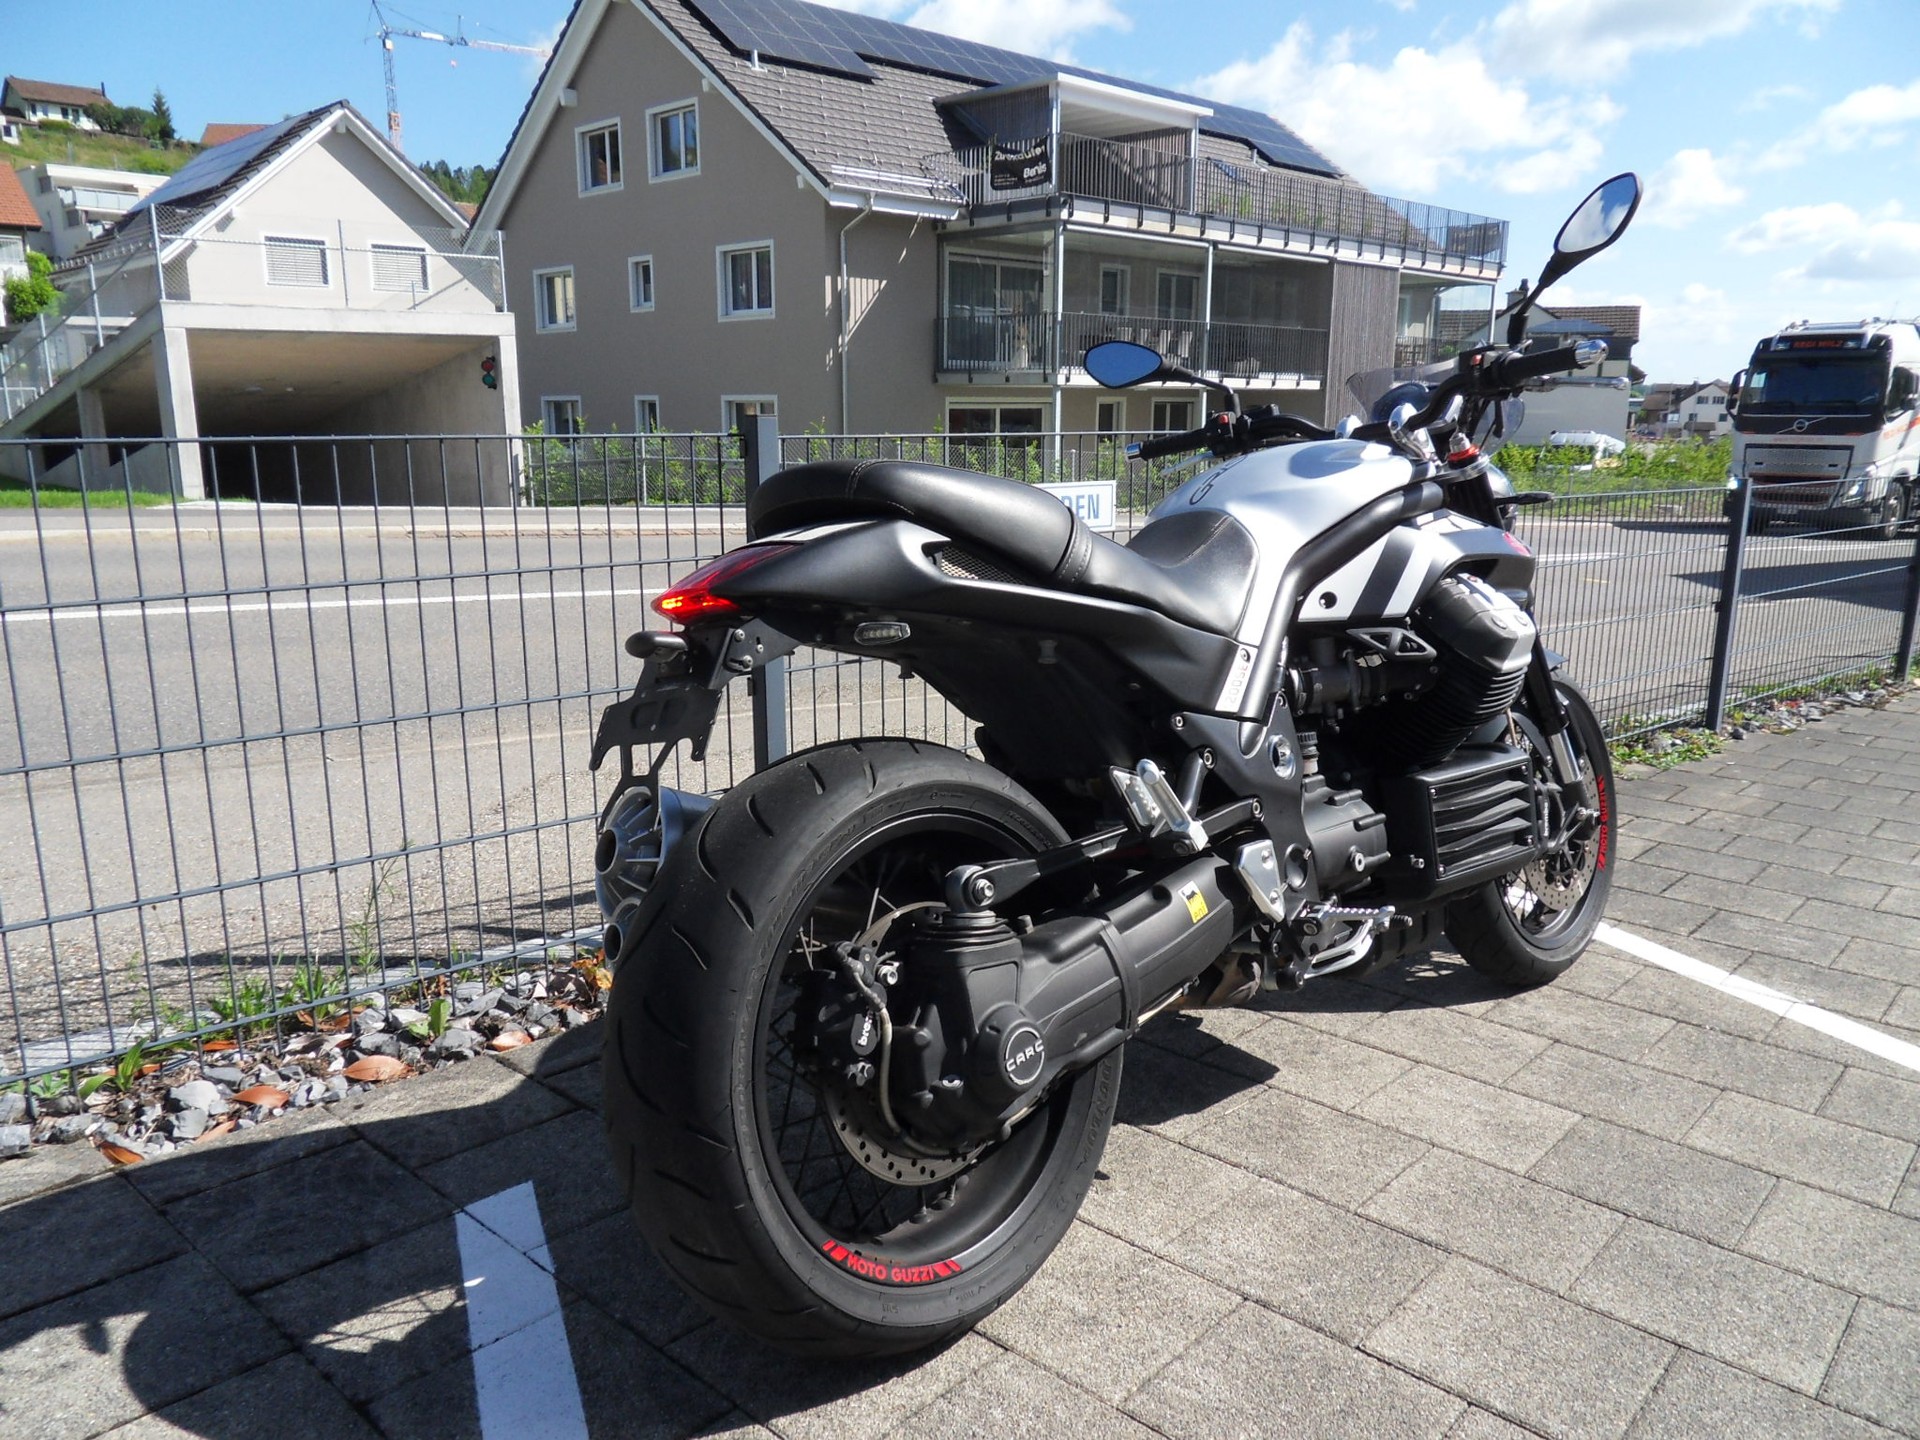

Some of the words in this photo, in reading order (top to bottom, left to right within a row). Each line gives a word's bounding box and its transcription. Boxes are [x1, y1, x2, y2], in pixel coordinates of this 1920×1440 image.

[1006, 1039, 1045, 1072] CARC
[847, 1253, 887, 1281] MOTO
[891, 1264, 936, 1284] GUZZI
